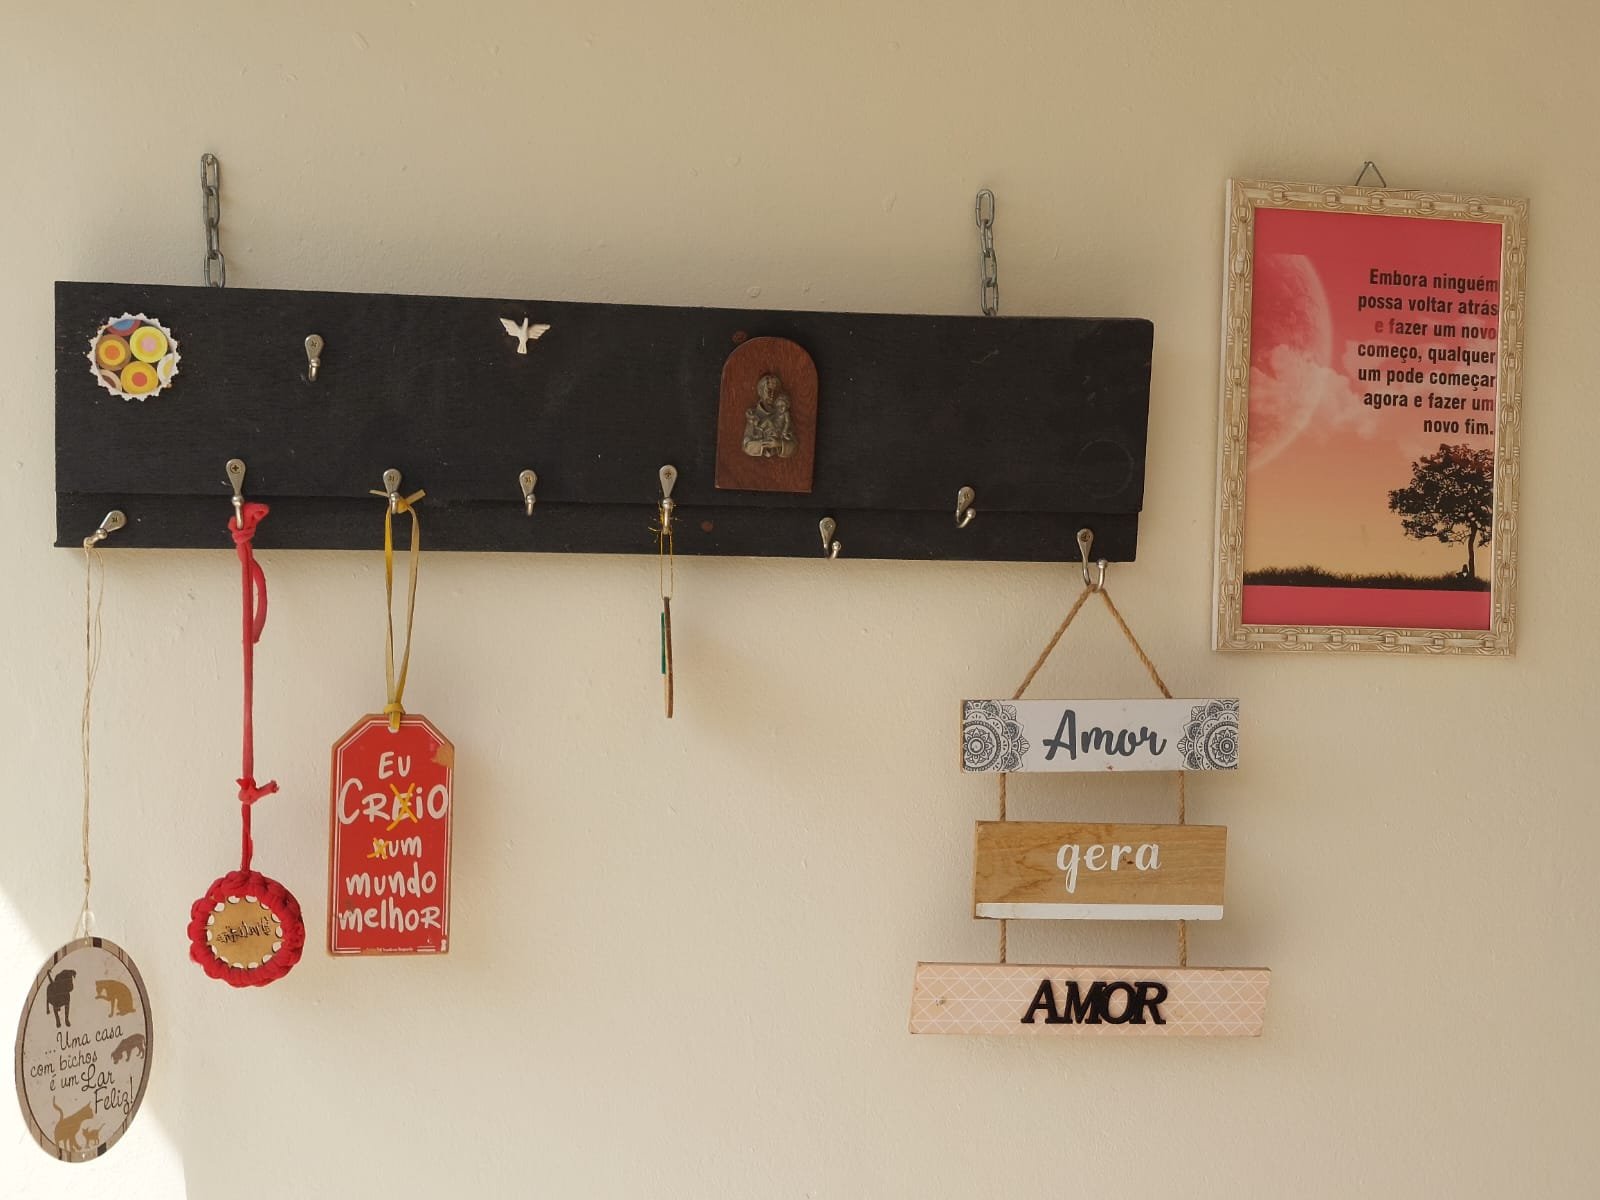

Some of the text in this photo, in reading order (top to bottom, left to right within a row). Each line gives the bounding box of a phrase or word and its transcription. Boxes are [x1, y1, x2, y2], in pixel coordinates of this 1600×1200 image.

[1369, 268, 1498, 293] Embora ninguém
[1358, 294, 1498, 316] possa voltar atrás
[1375, 318, 1497, 340] e fazer um novo
[1357, 343, 1496, 366] começo, qualquer
[1358, 368, 1496, 391] um pode começar
[1363, 392, 1494, 411] agora e fazer um
[1424, 418, 1494, 435] novo fim.
[1042, 709, 1167, 761] Amor
[345, 861, 437, 898] mundo
[1056, 842, 1161, 894] gera
[1020, 979, 1169, 1025] AMOR
[95, 1024, 124, 1042] casa
[30, 1050, 98, 1078] com bichos
[49, 1064, 115, 1091] é um Lar
[94, 1076, 135, 1115] Feliz!
